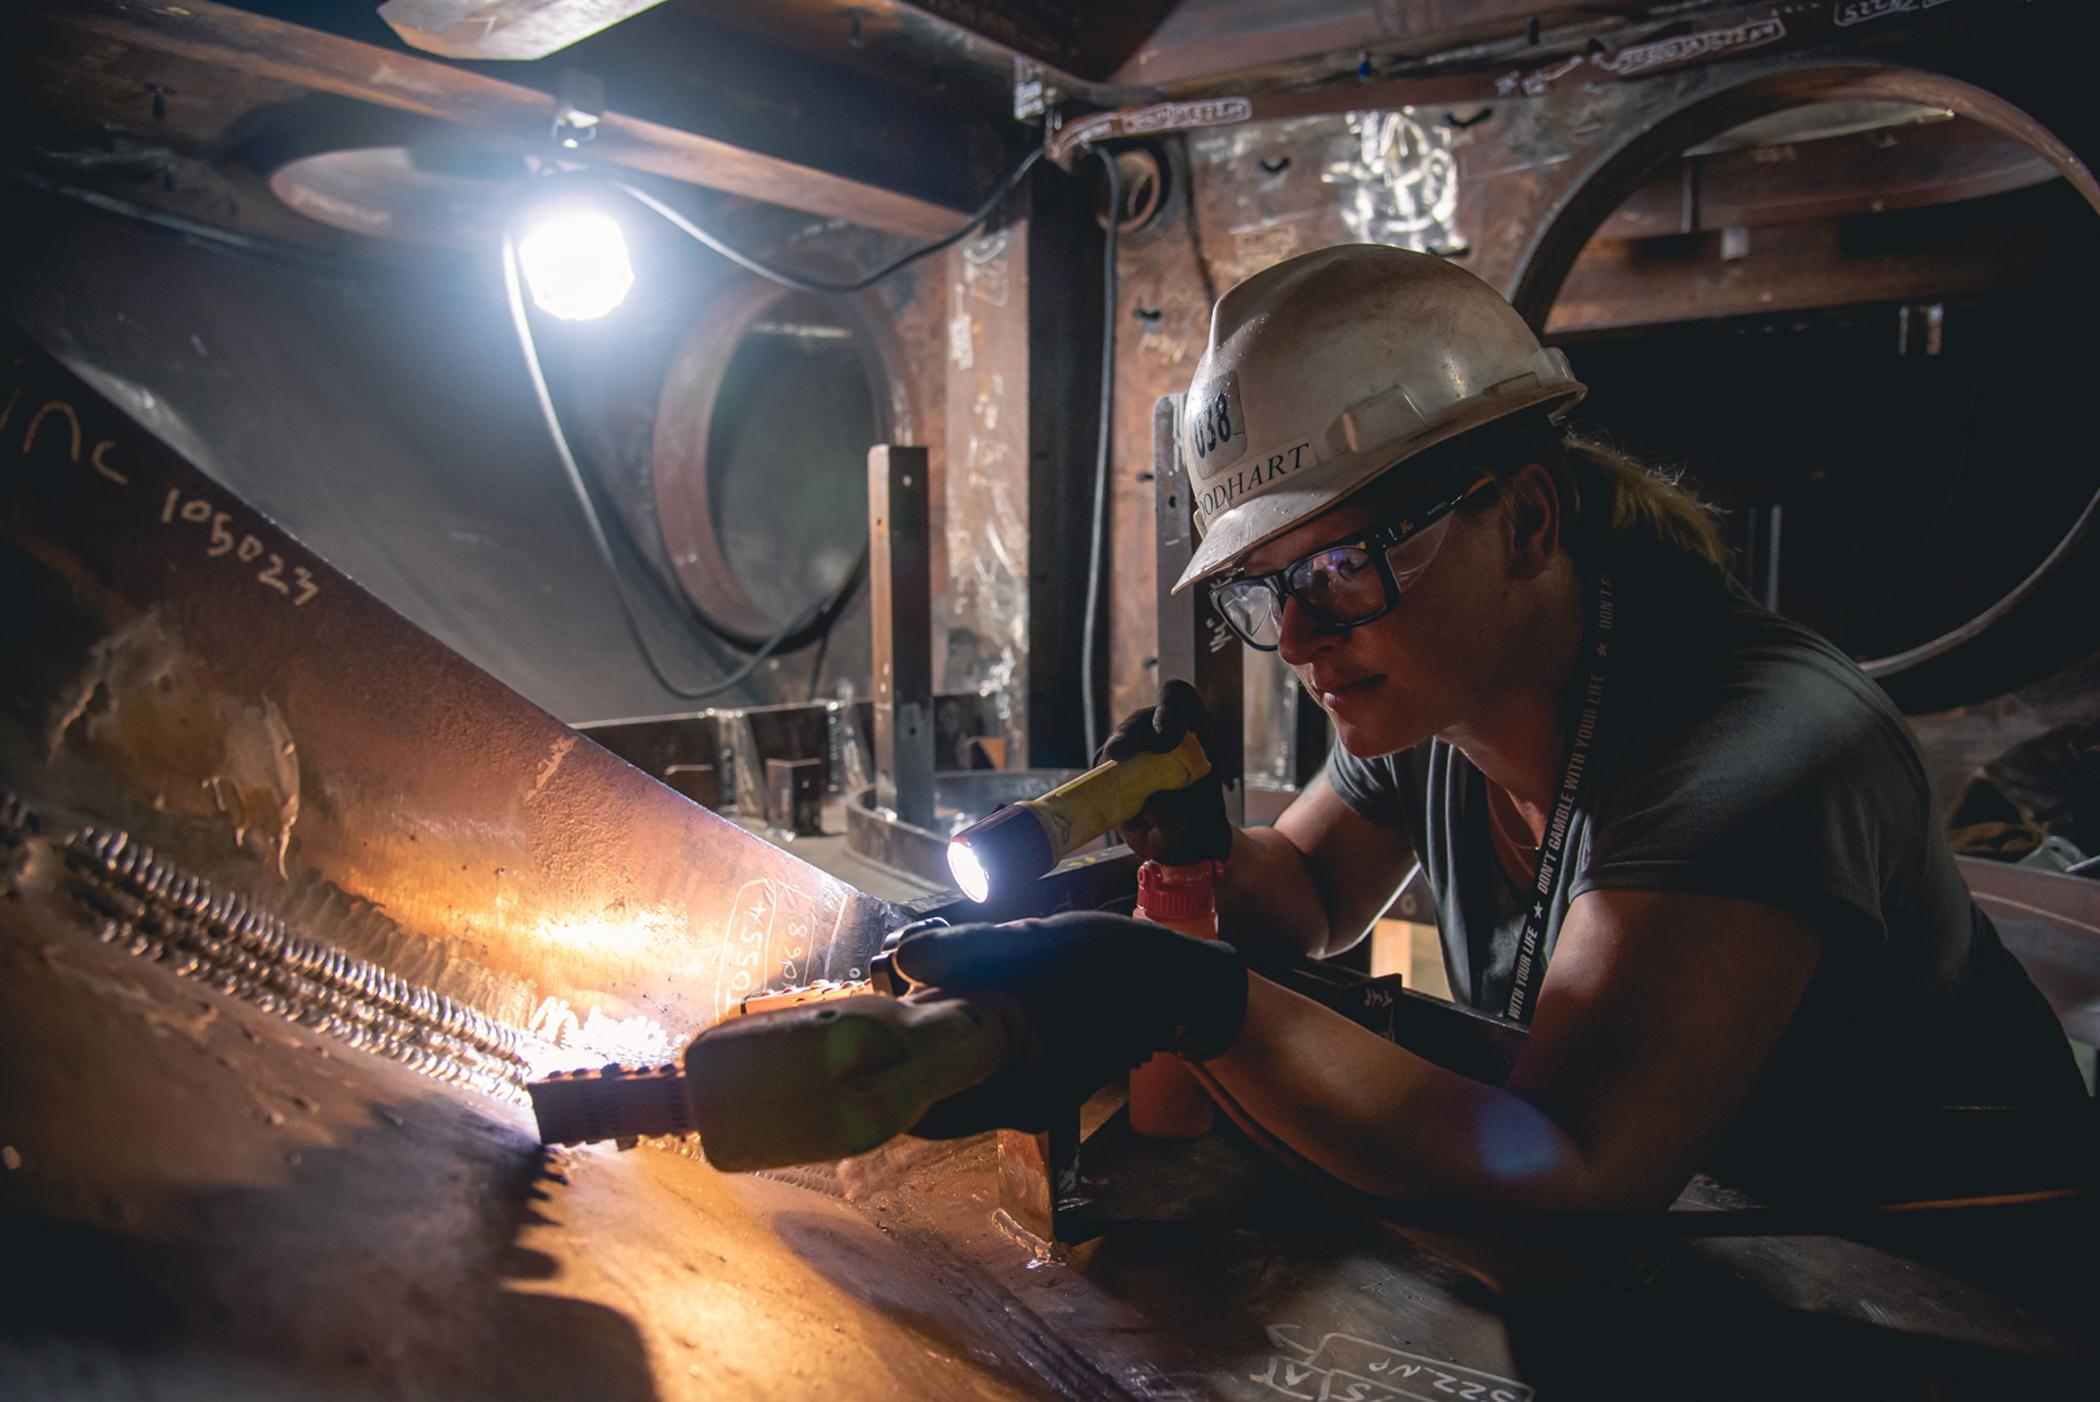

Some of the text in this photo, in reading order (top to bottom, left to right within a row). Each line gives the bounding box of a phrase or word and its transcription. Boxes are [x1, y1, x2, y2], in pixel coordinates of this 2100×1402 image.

[161, 488, 320, 606] 105023
[1586, 672, 1606, 705] LIFE
[1574, 707, 1599, 749] YOUR
[1563, 752, 1587, 791] WITH
[1548, 791, 1576, 850] GAMBLE
[1536, 850, 1558, 895] DON'T
[1522, 924, 1539, 957] LIFE
[1515, 954, 1533, 987] YOUR
